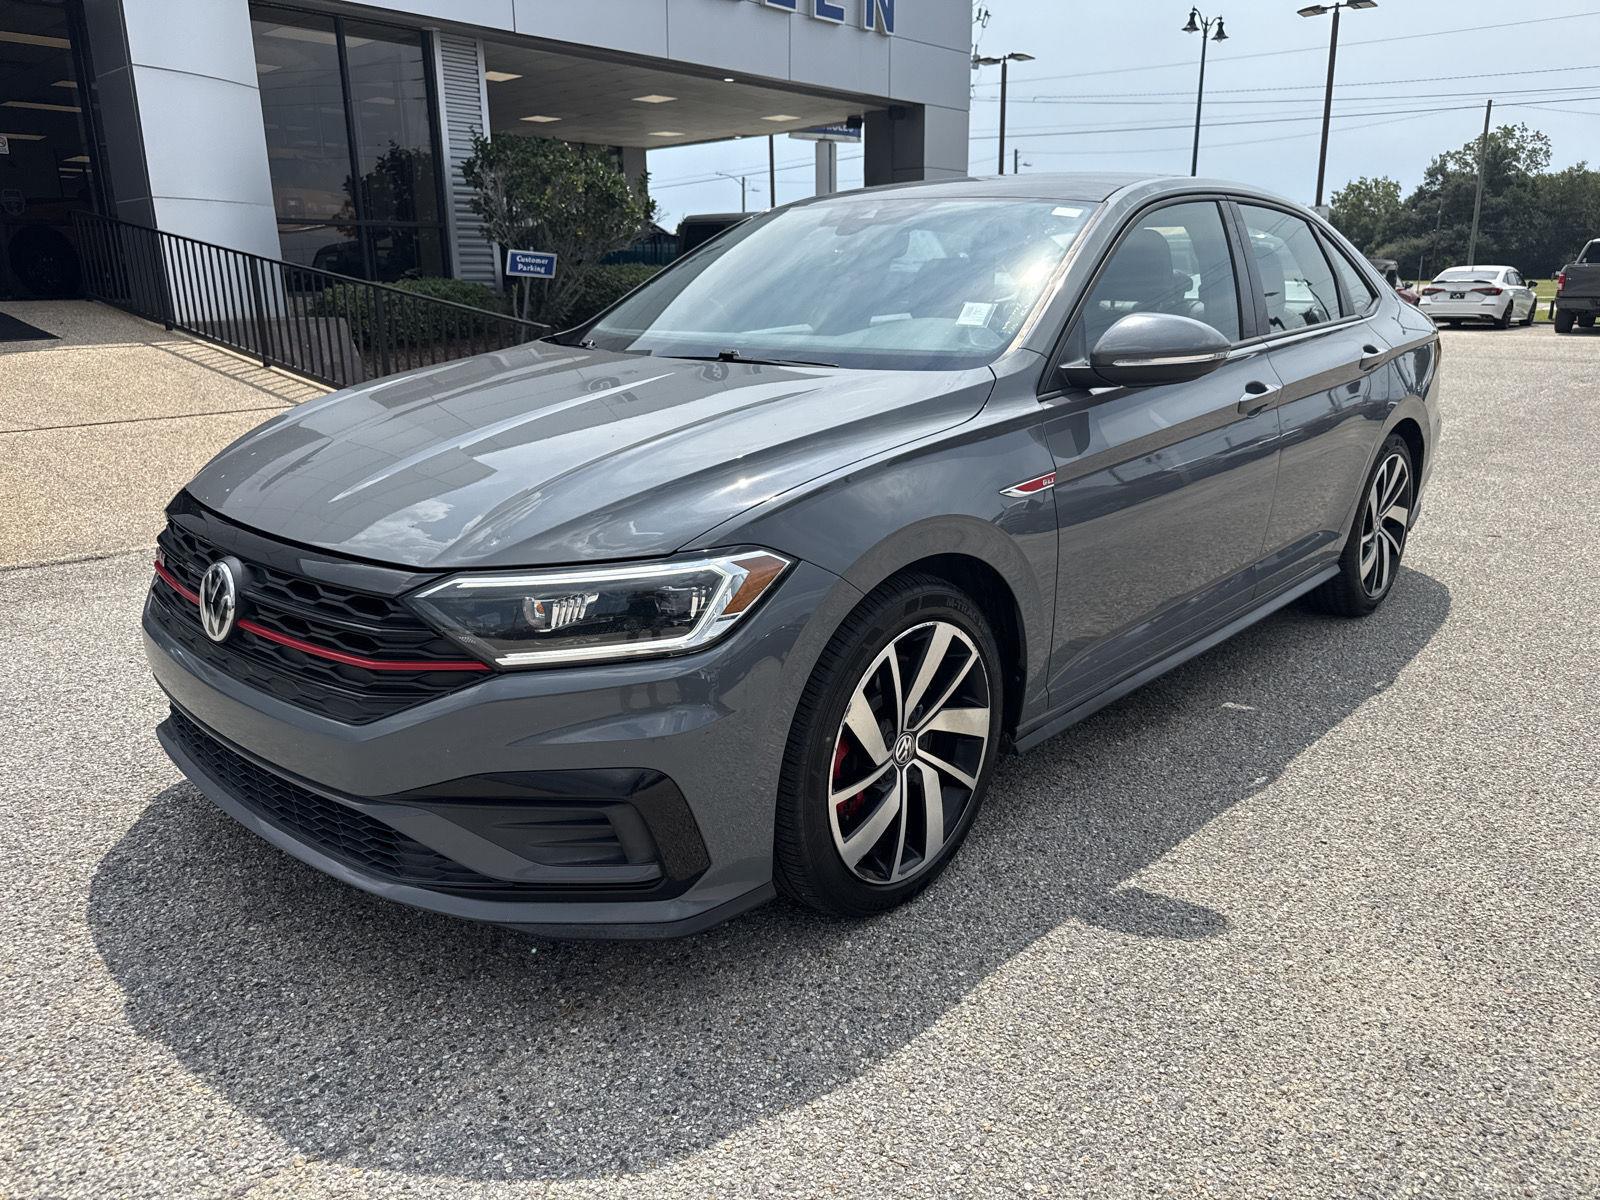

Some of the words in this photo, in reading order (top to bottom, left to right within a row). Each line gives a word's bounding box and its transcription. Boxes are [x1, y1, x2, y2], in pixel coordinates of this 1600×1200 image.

[516, 255, 549, 265] Customer
[517, 263, 546, 274] Parking
[1042, 477, 1055, 486] GLI
